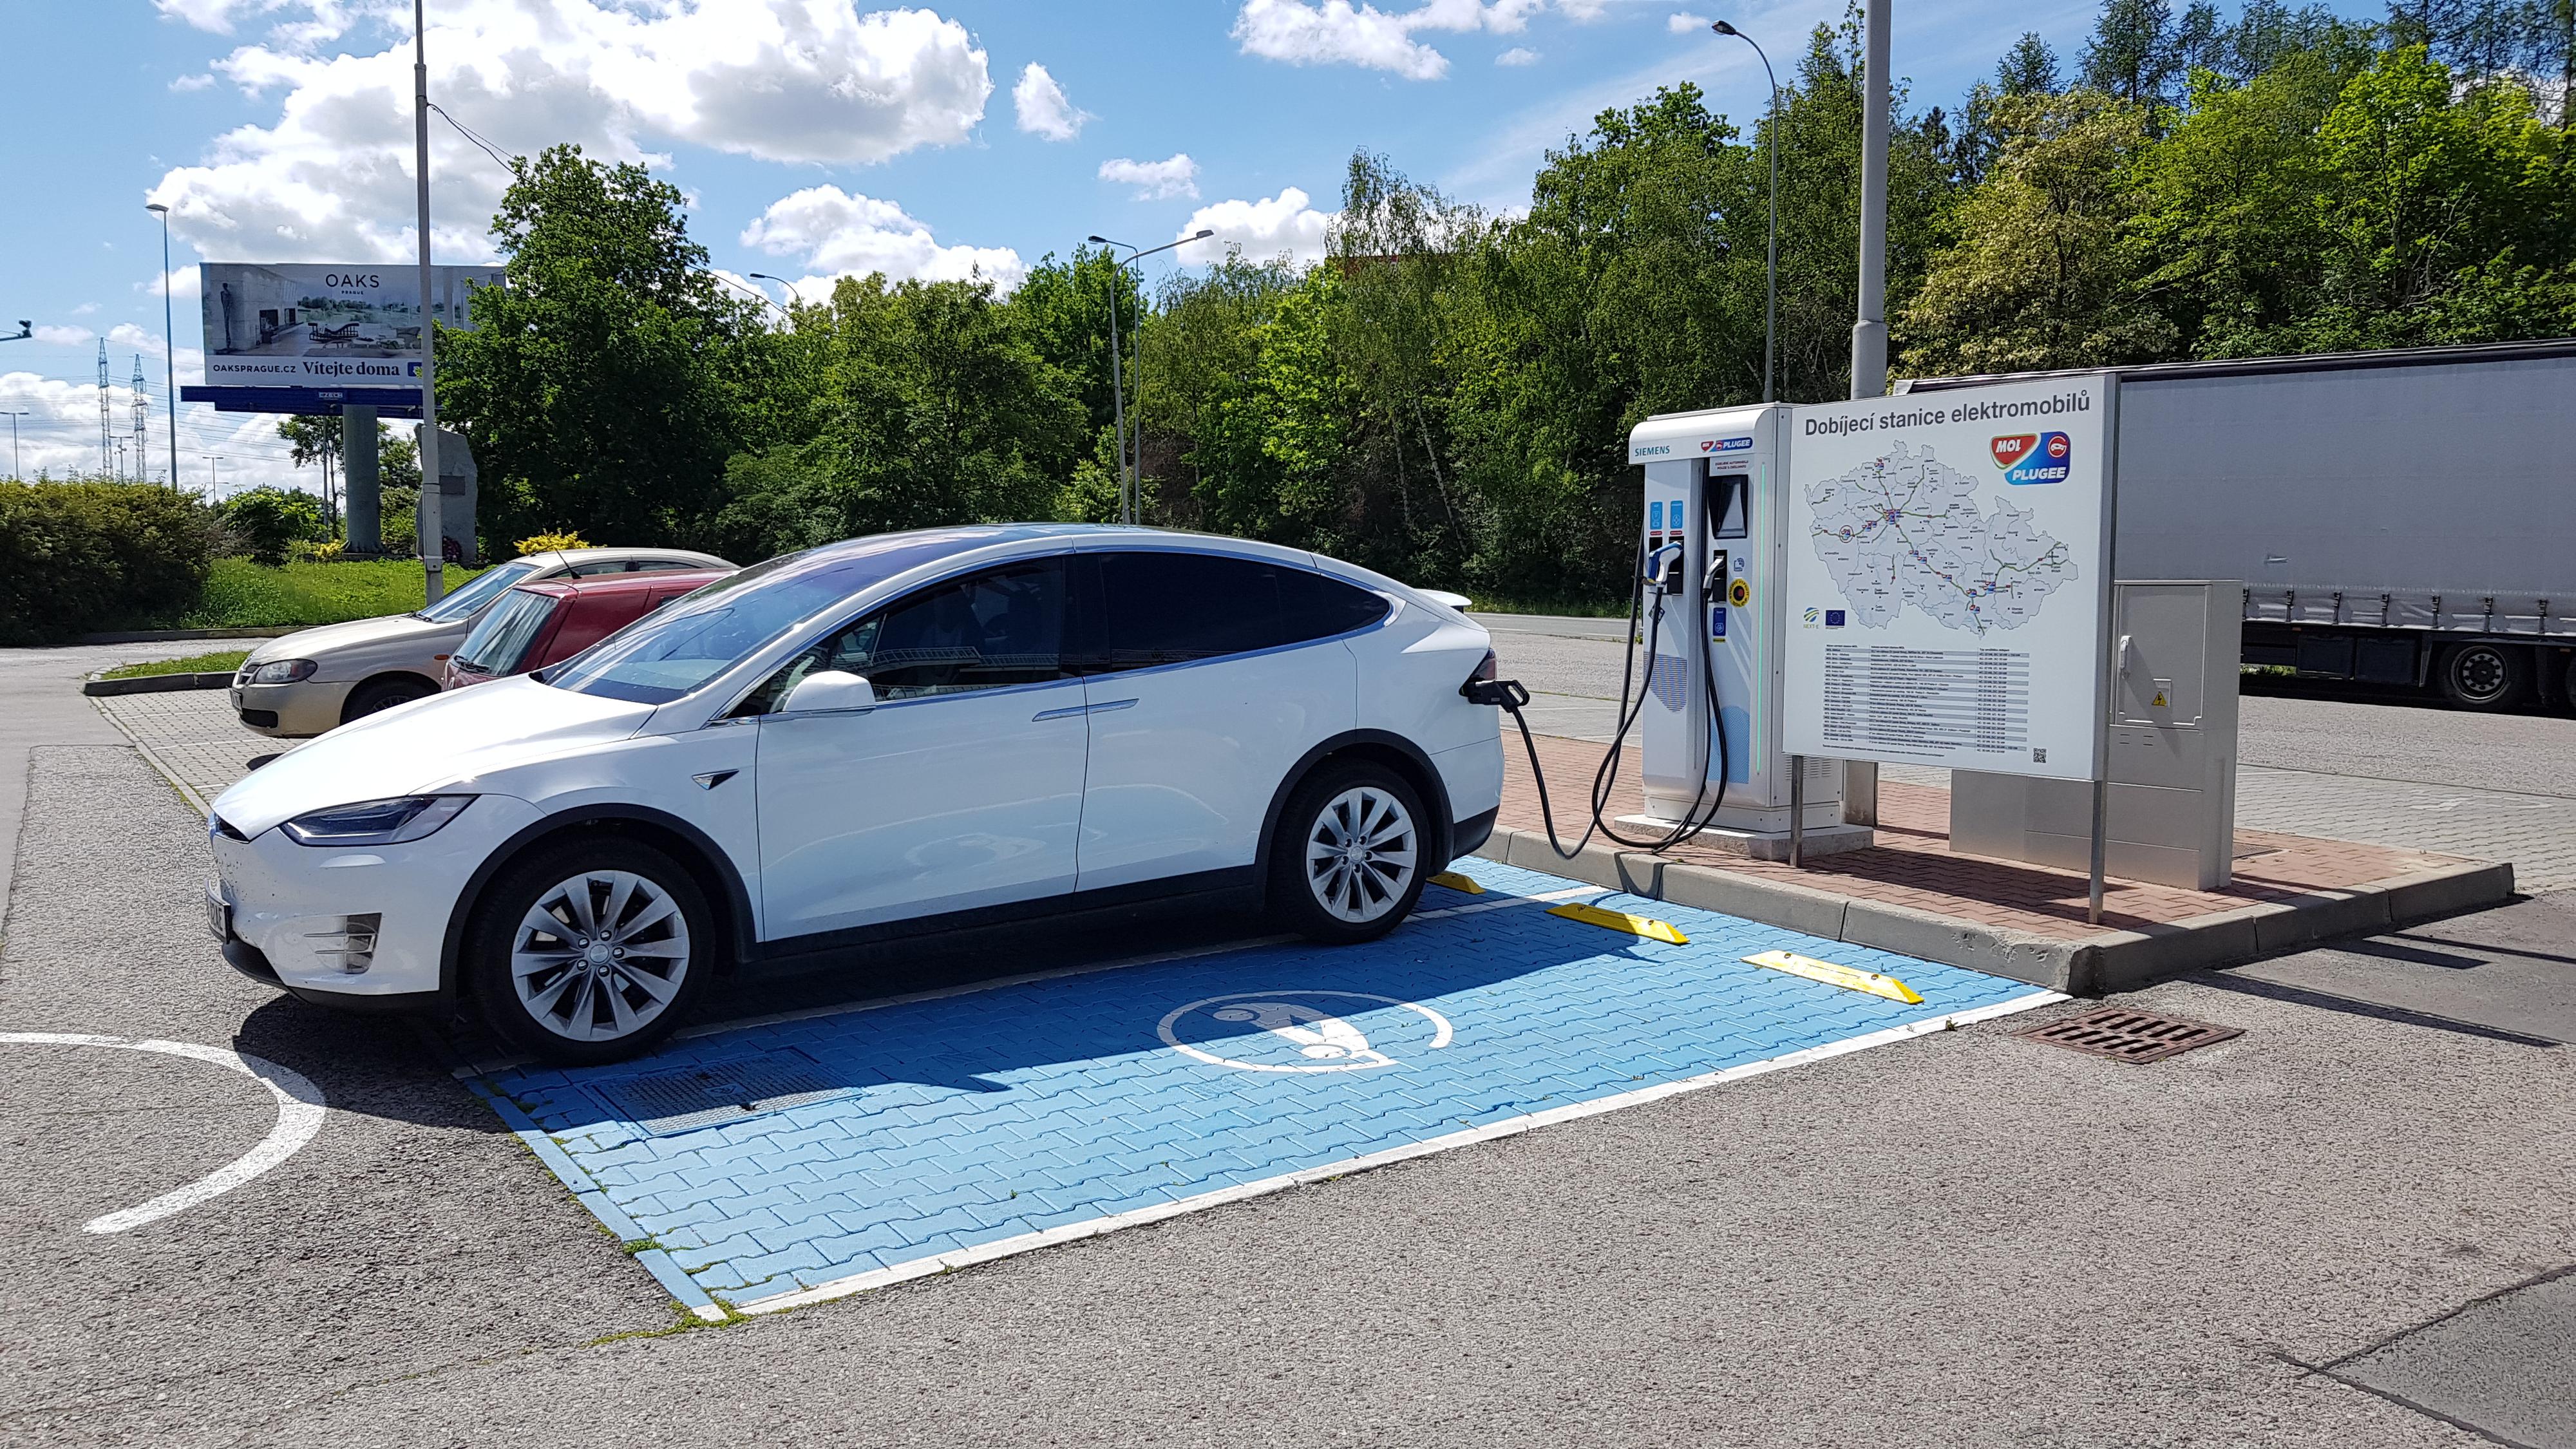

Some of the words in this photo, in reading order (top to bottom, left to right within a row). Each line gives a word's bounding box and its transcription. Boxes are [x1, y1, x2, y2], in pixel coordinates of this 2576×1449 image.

[326, 274, 379, 288] OAKS
[213, 365, 296, 373] OAKSPRAGUE.CZ
[303, 361, 353, 377] Vítejte
[356, 362, 400, 375] doma
[1805, 412, 1875, 437] Dobíjecí
[1879, 408, 1946, 430] stanice
[1951, 390, 2090, 422] elektromobilů
[1634, 445, 1670, 457] SIEMENS
[1723, 439, 1750, 449] PLUGEE
[1996, 439, 2022, 453] MOL
[2012, 467, 2067, 481] PLUGEE
